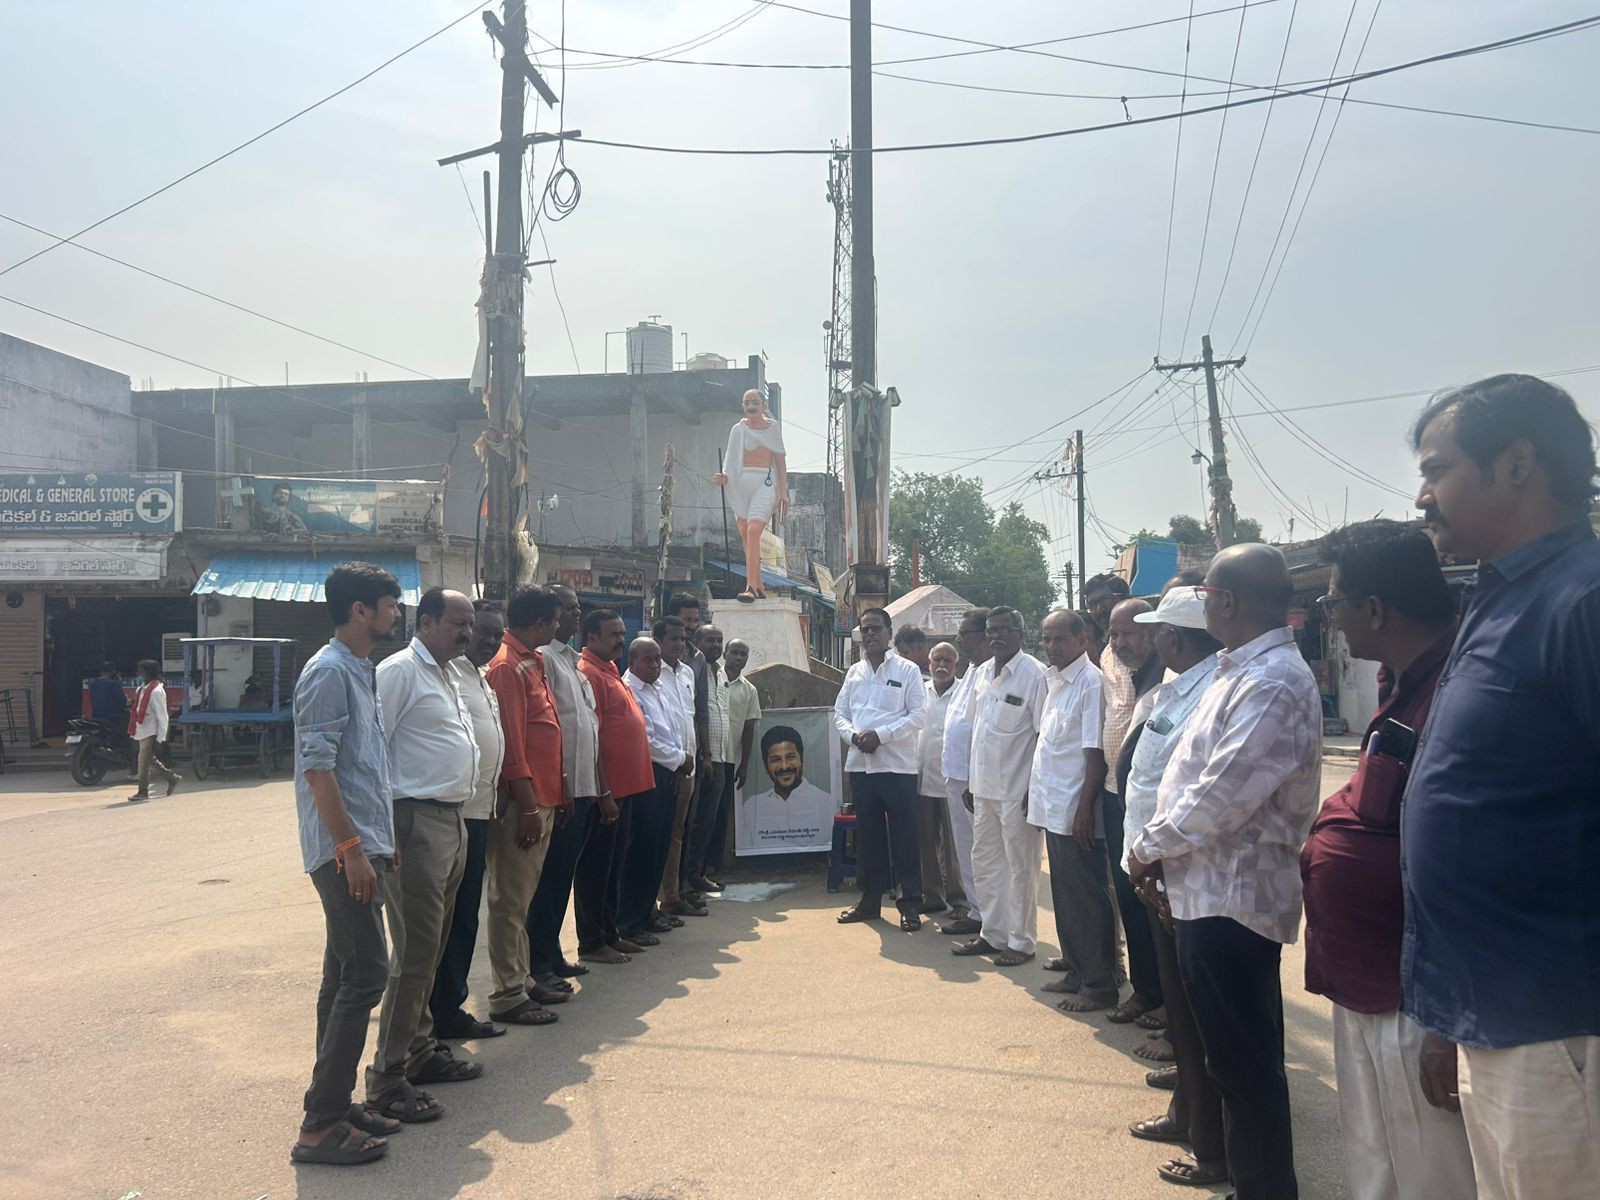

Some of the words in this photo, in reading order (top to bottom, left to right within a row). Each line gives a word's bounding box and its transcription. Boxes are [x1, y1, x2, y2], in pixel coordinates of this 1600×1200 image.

[36, 488, 44, 503] &
[47, 487, 97, 504] GENERAL
[99, 487, 135, 504] STORE
[39, 509, 52, 523] &
